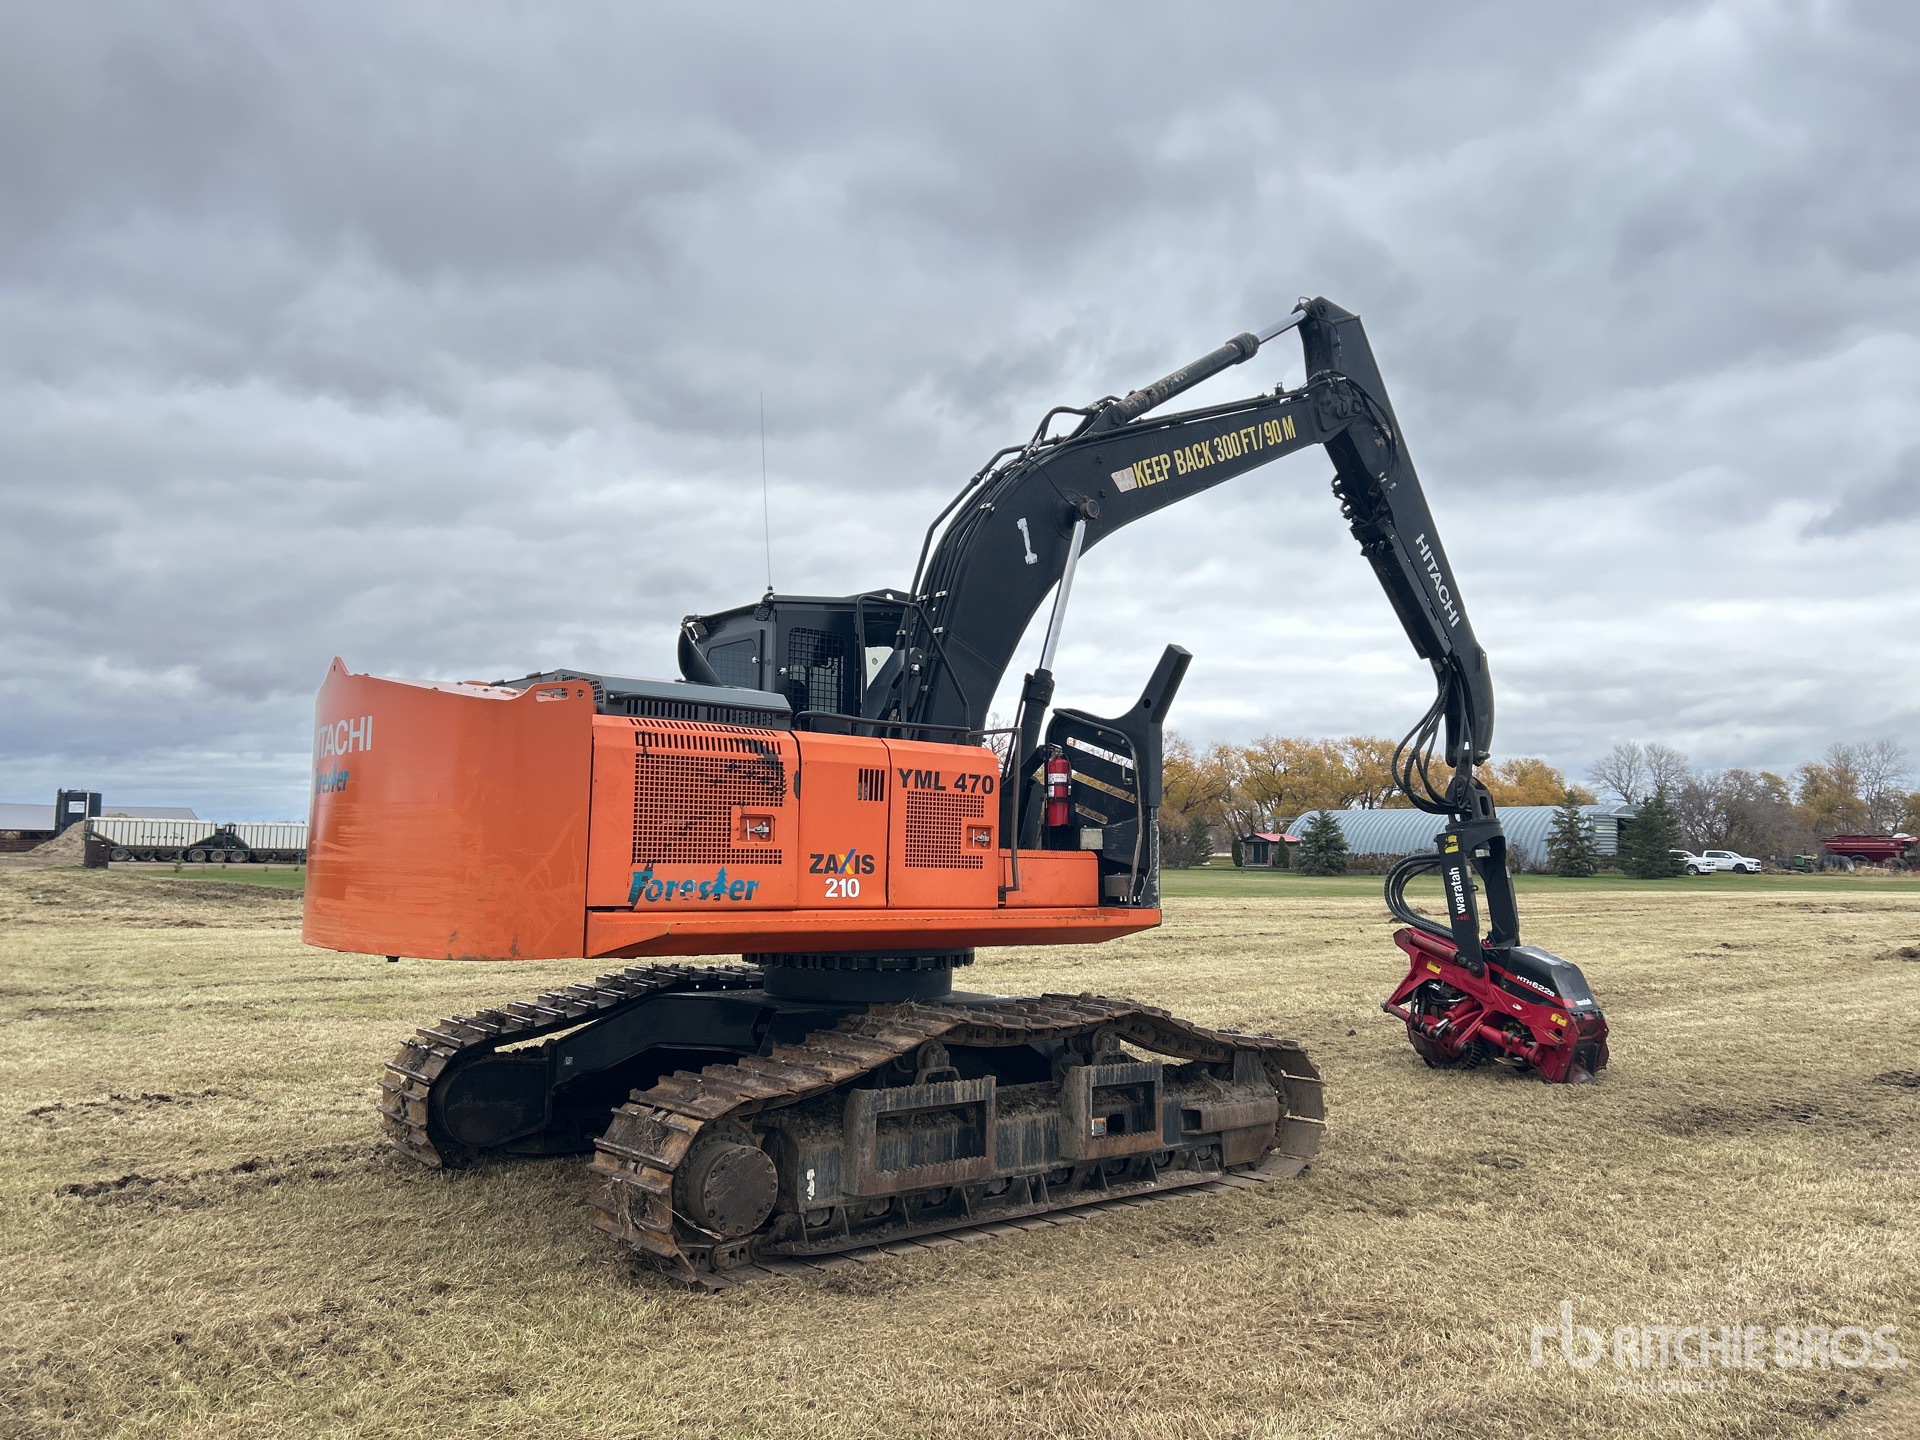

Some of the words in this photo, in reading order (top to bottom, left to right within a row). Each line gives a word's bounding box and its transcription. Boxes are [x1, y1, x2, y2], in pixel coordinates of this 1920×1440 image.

[1132, 453, 1171, 488] KEEP
[1174, 440, 1215, 475] BACK
[1213, 432, 1241, 462] 300
[1282, 415, 1296, 440] M
[1415, 533, 1460, 628] HITACHI
[314, 715, 373, 760] ITACHI
[897, 768, 946, 791] YML
[954, 773, 994, 794] 470
[809, 848, 875, 875] ZAXIS
[628, 866, 760, 905] Forester
[825, 877, 860, 898] 210
[1449, 866, 1466, 914] waratah
